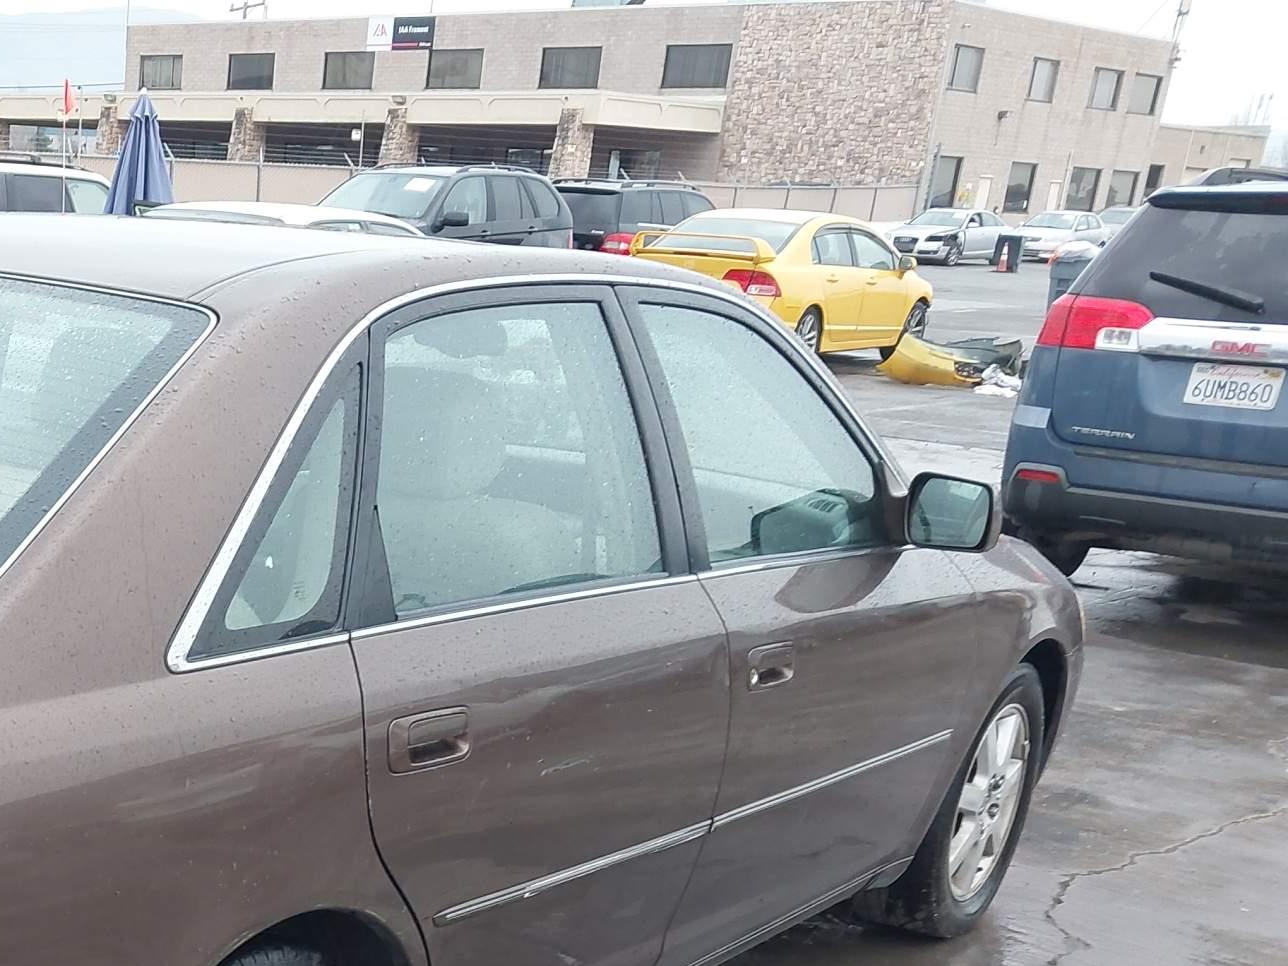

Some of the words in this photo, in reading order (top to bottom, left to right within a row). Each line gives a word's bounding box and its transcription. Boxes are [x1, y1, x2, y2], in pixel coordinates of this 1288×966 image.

[1211, 340, 1272, 357] GMC
[1191, 379, 1273, 403] 6UMB860
[1071, 426, 1136, 439] TERRAIN
